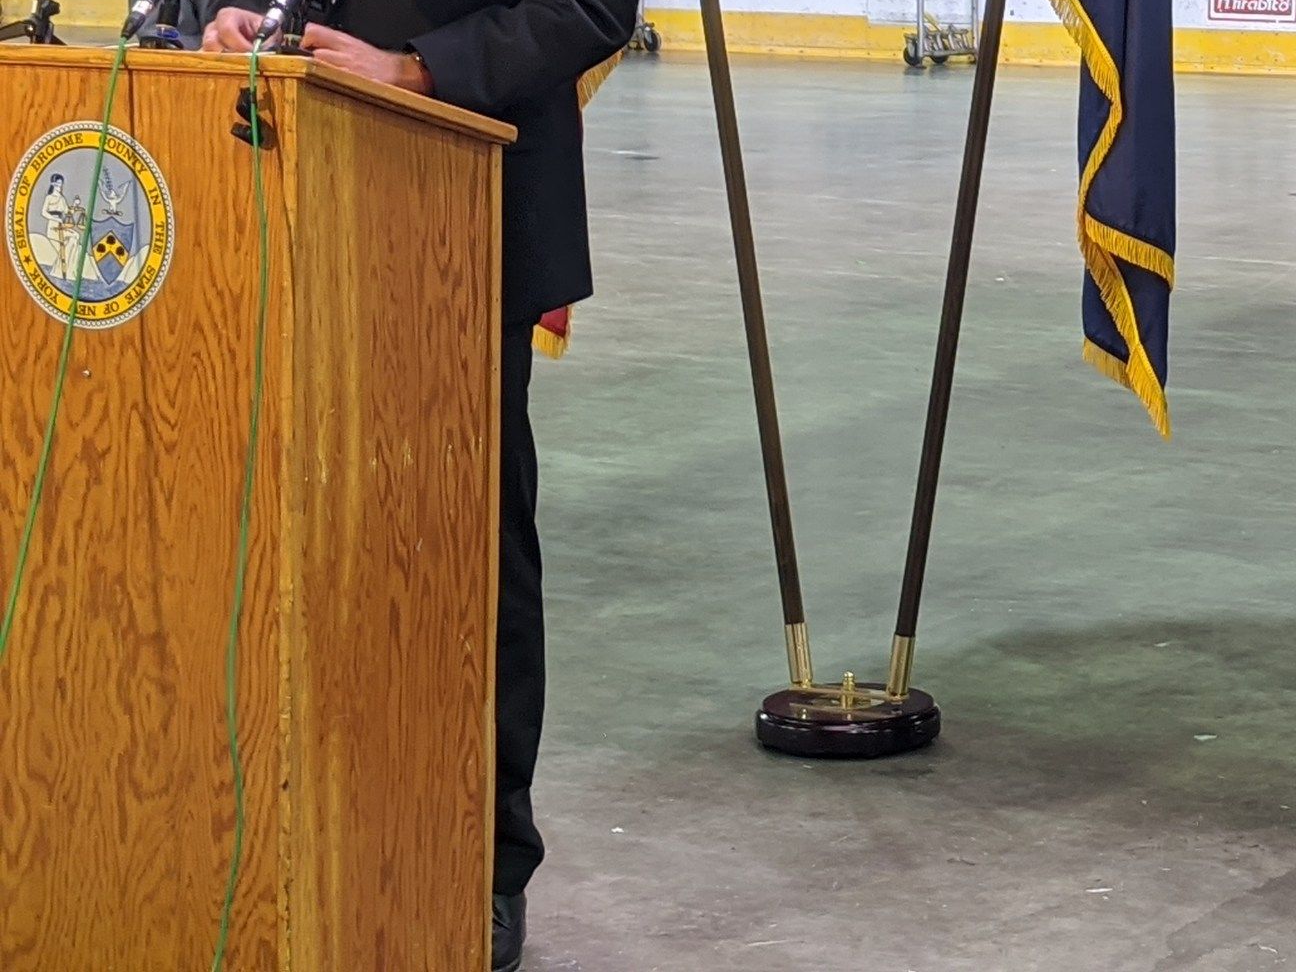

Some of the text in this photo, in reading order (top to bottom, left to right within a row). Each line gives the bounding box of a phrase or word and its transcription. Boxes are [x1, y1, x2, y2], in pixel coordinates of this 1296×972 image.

[32, 132, 84, 173] BROOME
[19, 175, 30, 197] OF
[149, 188, 161, 206] IN
[14, 206, 27, 250] SEAL
[153, 221, 165, 255] THE
[29, 267, 59, 305] YORK
[126, 265, 156, 305] STATE
[104, 300, 120, 316] OF
